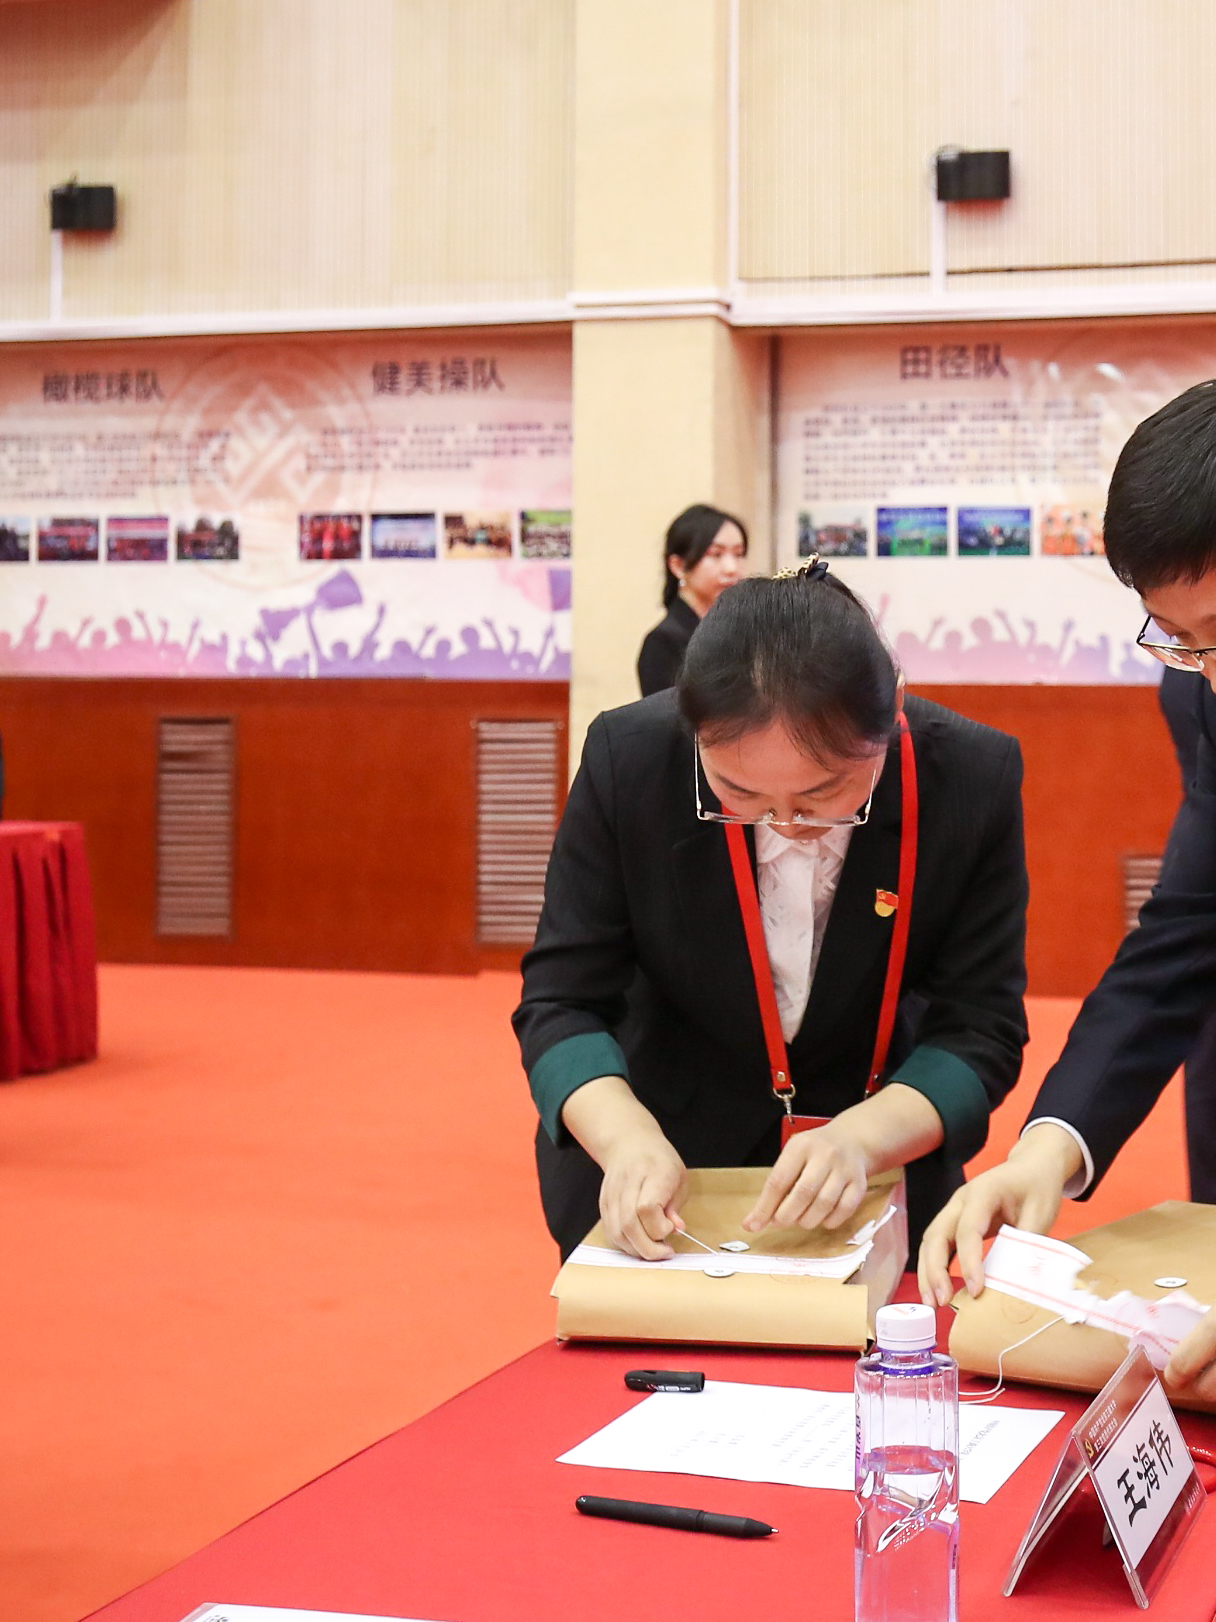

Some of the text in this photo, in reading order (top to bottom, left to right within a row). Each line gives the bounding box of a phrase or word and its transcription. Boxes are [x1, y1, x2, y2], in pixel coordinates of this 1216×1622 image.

[372, 357, 505, 396] 健美操队
[900, 344, 1010, 379] 田径队
[42, 369, 166, 403] 橄榄球队
[1117, 1420, 1174, 1528] 王海伟
